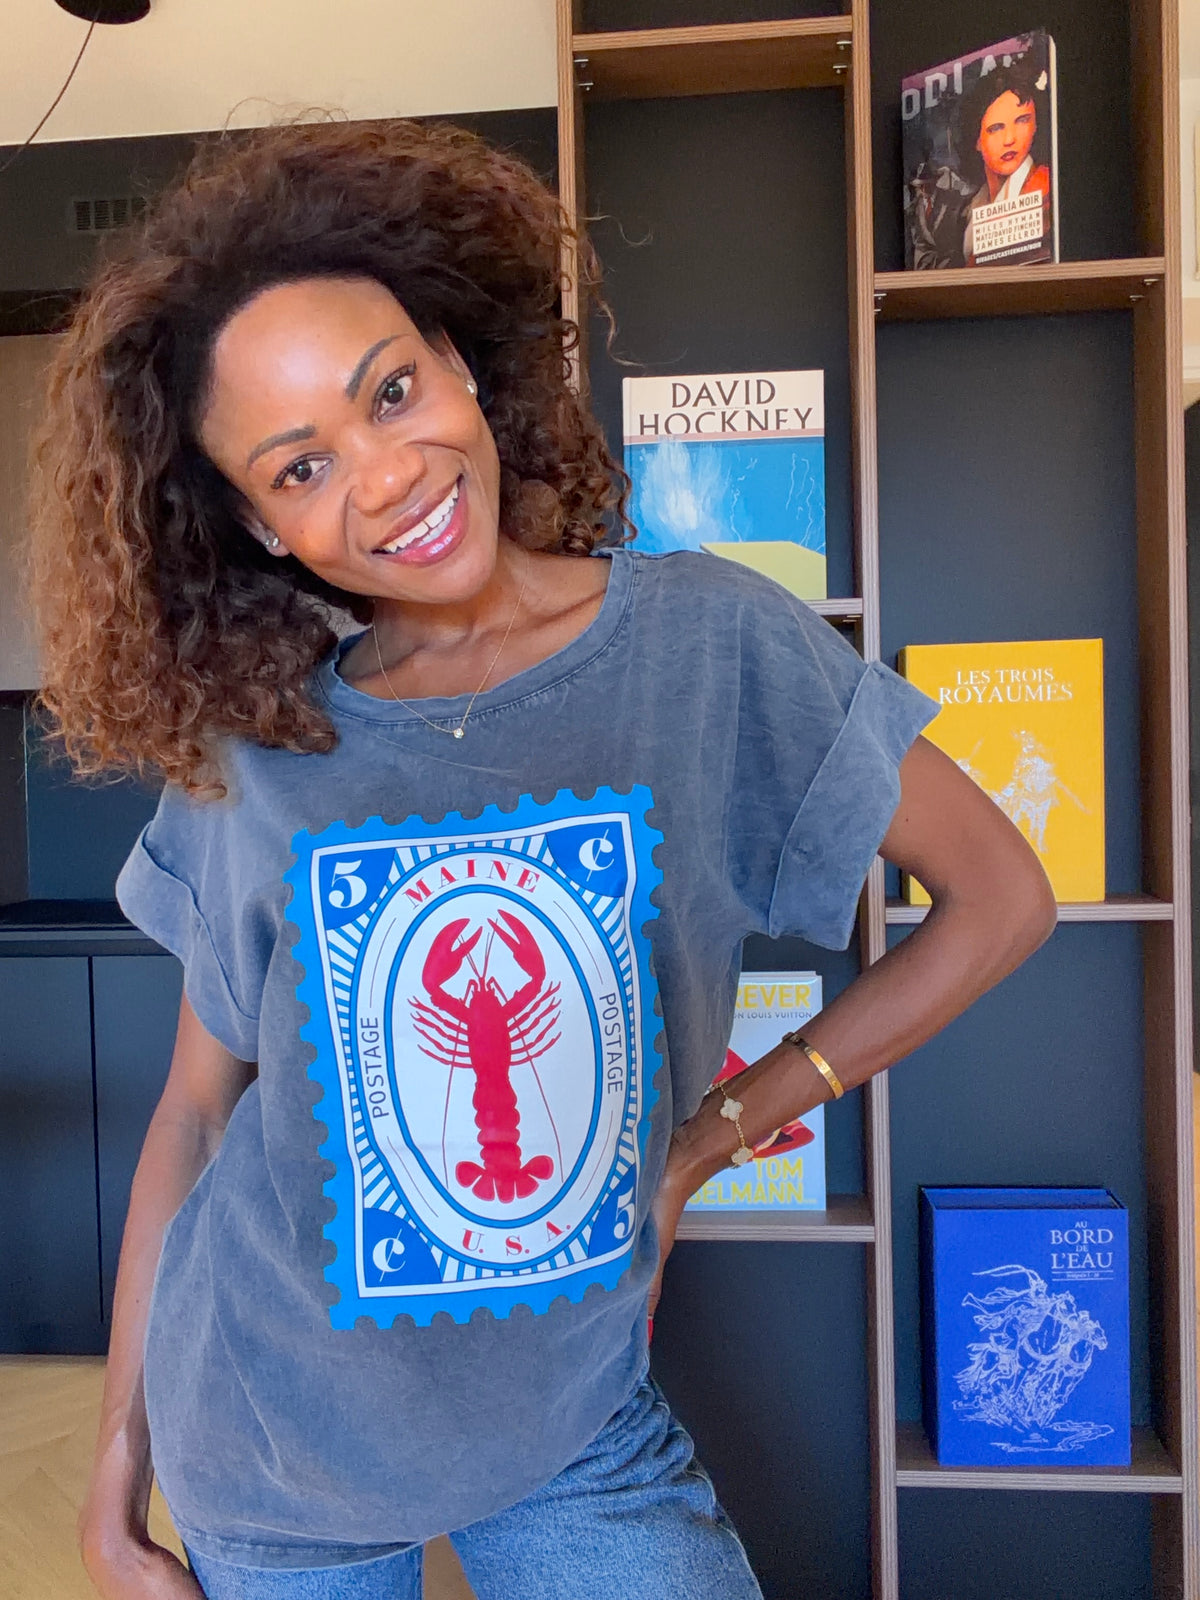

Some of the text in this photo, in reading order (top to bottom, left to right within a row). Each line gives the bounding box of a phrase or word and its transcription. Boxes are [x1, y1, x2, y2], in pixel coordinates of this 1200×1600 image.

[975, 195, 1040, 220] LE DAHLIA NOIR
[976, 228, 1041, 251] JAMES ELLROY
[671, 378, 776, 409] DAVID
[639, 407, 813, 436] HOCKNEY
[957, 667, 1055, 685] LES TROIS
[939, 683, 1073, 704] ROYAUMES
[328, 859, 368, 909] 5
[401, 858, 541, 910] MAINE
[747, 1011, 773, 1019] LOUIS
[774, 1011, 812, 1019] VUITTON
[599, 992, 624, 1095] POSTAGE
[360, 1017, 390, 1119] POSTAGE
[752, 1157, 804, 1180] TOM
[613, 1191, 636, 1240] 5
[1075, 1221, 1088, 1229] AU
[1050, 1229, 1114, 1245] BORD
[1050, 1252, 1113, 1269] L'EAU
